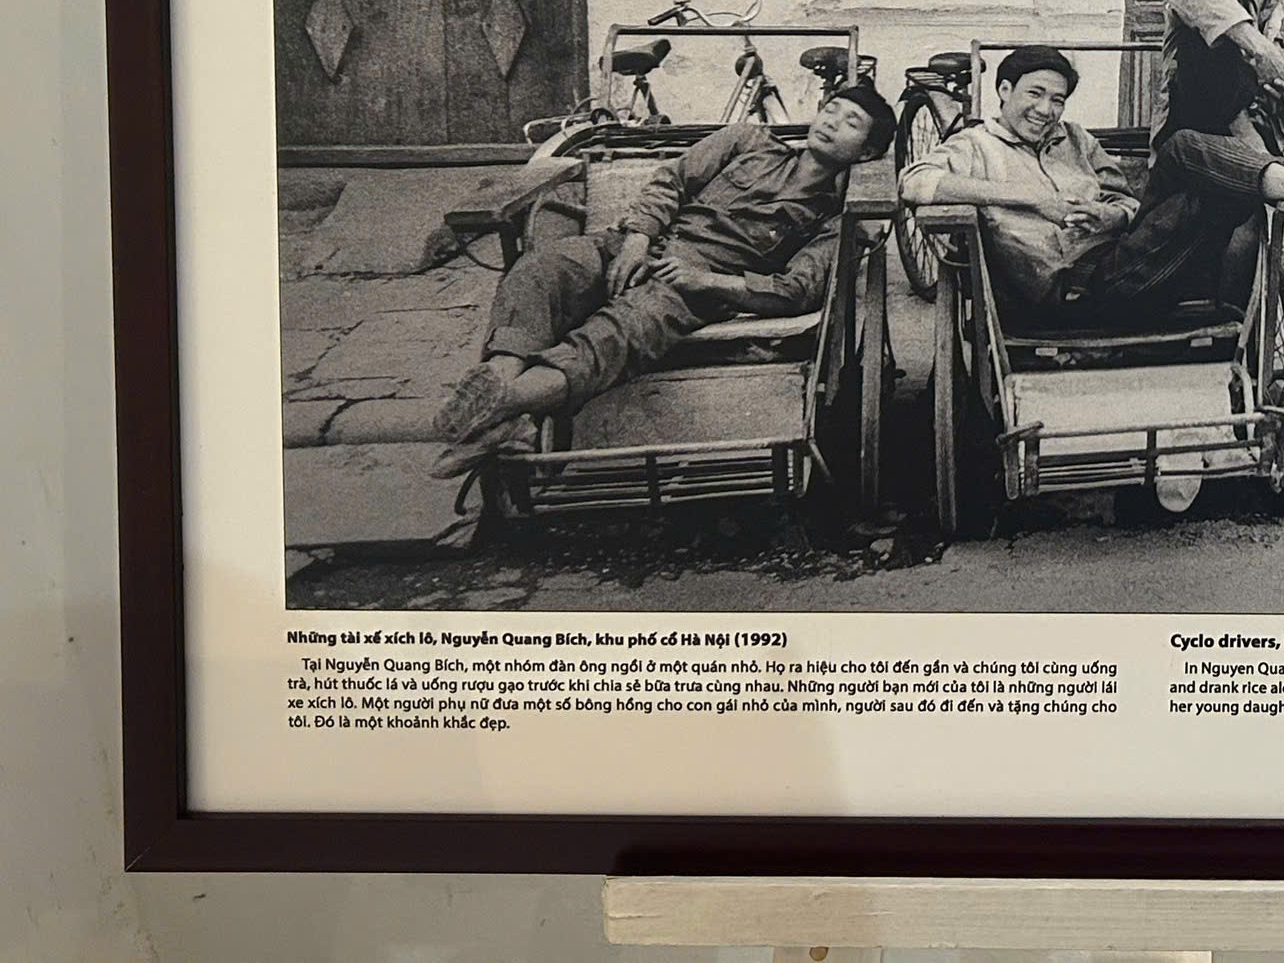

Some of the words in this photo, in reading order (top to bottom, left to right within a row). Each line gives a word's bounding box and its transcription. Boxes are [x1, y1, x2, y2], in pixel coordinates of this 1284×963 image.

[340, 632, 360, 644] tài
[384, 632, 415, 645] xích
[419, 631, 437, 646] lô,
[502, 633, 552, 648] Quang
[555, 633, 592, 647] Bích,
[595, 633, 624, 646] khu
[680, 633, 701, 646] Hà
[704, 633, 730, 649] Nội
[734, 632, 787, 648] (1992)
[1170, 633, 1214, 652] Cyclo
[1218, 633, 1281, 650] drivers,
[302, 657, 321, 674] Tại
[383, 658, 430, 675] Quang
[434, 658, 468, 673] Bích,
[472, 659, 501, 674] một
[504, 658, 545, 672] nhóm
[548, 659, 575, 672] đàn
[579, 660, 607, 675] ông
[659, 660, 688, 675] một
[691, 660, 727, 676] quán
[766, 660, 785, 676] Họ
[789, 663, 802, 674] ra
[806, 660, 836, 676] hiệu
[840, 660, 866, 673] cho
[870, 661, 888, 673] tôi
[953, 661, 969, 674] và
[972, 661, 1016, 677] chúng
[1020, 661, 1039, 674] tôi
[1042, 661, 1077, 677] cùng
[1184, 661, 1198, 674] In
[1201, 662, 1254, 678] Nguyen
[287, 677, 311, 691] trà,
[314, 676, 338, 690] hút
[386, 677, 398, 691] lá
[401, 677, 417, 690] và
[498, 681, 524, 694] gạo
[568, 679, 589, 691] khi
[593, 679, 622, 692] chia
[674, 681, 703, 692] trưa
[706, 679, 741, 695] cùng
[745, 679, 784, 693] nhau.
[882, 679, 908, 696] bạn
[970, 680, 989, 693] tôi
[993, 680, 1005, 693] là
[1101, 680, 1117, 693] lái
[1170, 680, 1195, 693] and
[1199, 680, 1239, 693] drank
[1242, 681, 1267, 694] rice
[287, 699, 304, 709] xe
[307, 696, 336, 709] xích
[340, 696, 357, 709] lô.
[361, 696, 390, 712] Một
[438, 697, 466, 713] phụ
[492, 697, 519, 711] đưa
[523, 697, 552, 713] một
[575, 698, 612, 714] bông
[656, 698, 683, 711] cho
[686, 701, 712, 711] con
[716, 698, 738, 714] gái
[802, 698, 841, 713] mình,
[890, 702, 913, 712] sau
[917, 699, 936, 712] đó
[940, 699, 953, 712] đi
[988, 699, 1004, 713] và
[1043, 699, 1087, 716] chúng
[1091, 699, 1117, 713] cho
[1170, 699, 1193, 713] her
[1195, 703, 1239, 716] young
[288, 715, 311, 728] tôi.
[314, 715, 335, 728] Đó
[338, 715, 351, 728] là
[354, 715, 383, 731] một
